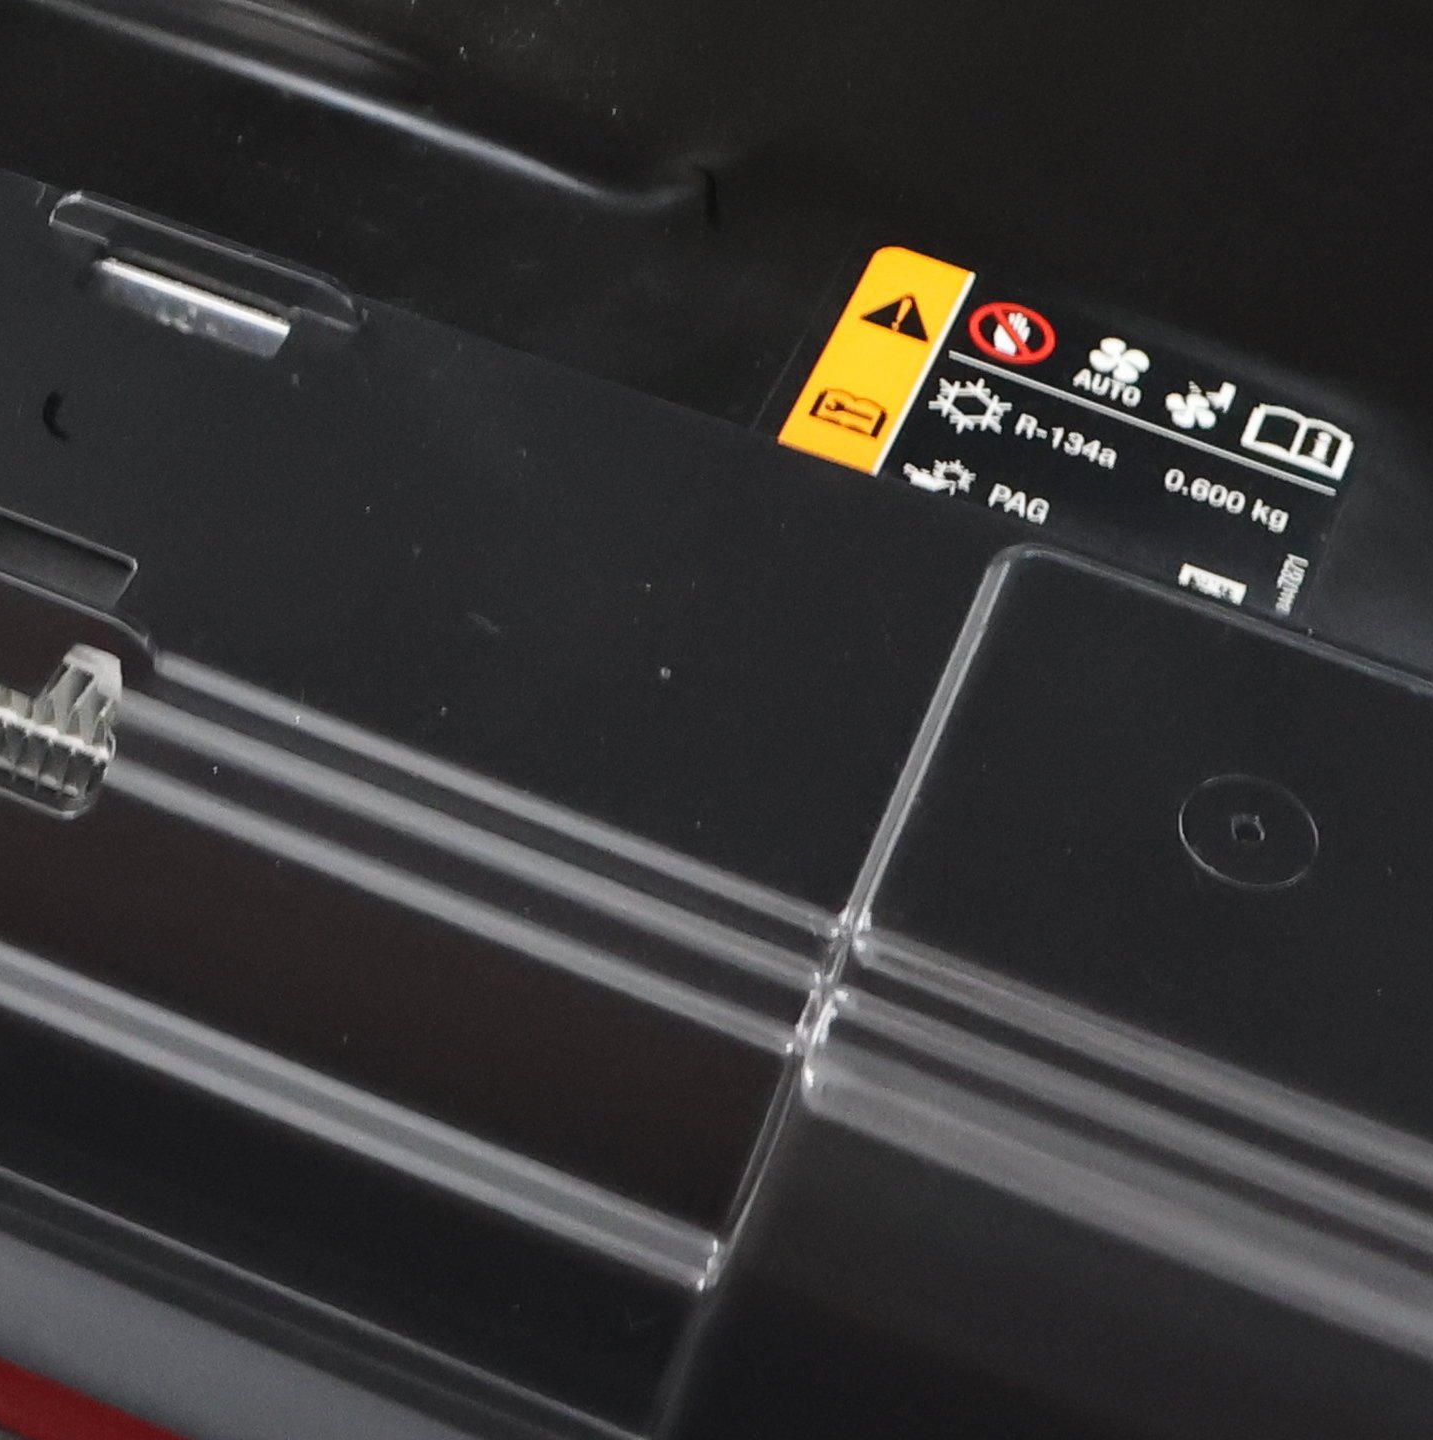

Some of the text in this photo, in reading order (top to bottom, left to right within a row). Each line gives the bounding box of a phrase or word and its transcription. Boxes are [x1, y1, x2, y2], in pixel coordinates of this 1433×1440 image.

[1072, 368, 1142, 408] AUTO
[1014, 413, 1118, 469] R-134a
[988, 483, 1050, 525] PAG
[1164, 468, 1289, 533] 0.600 kg
